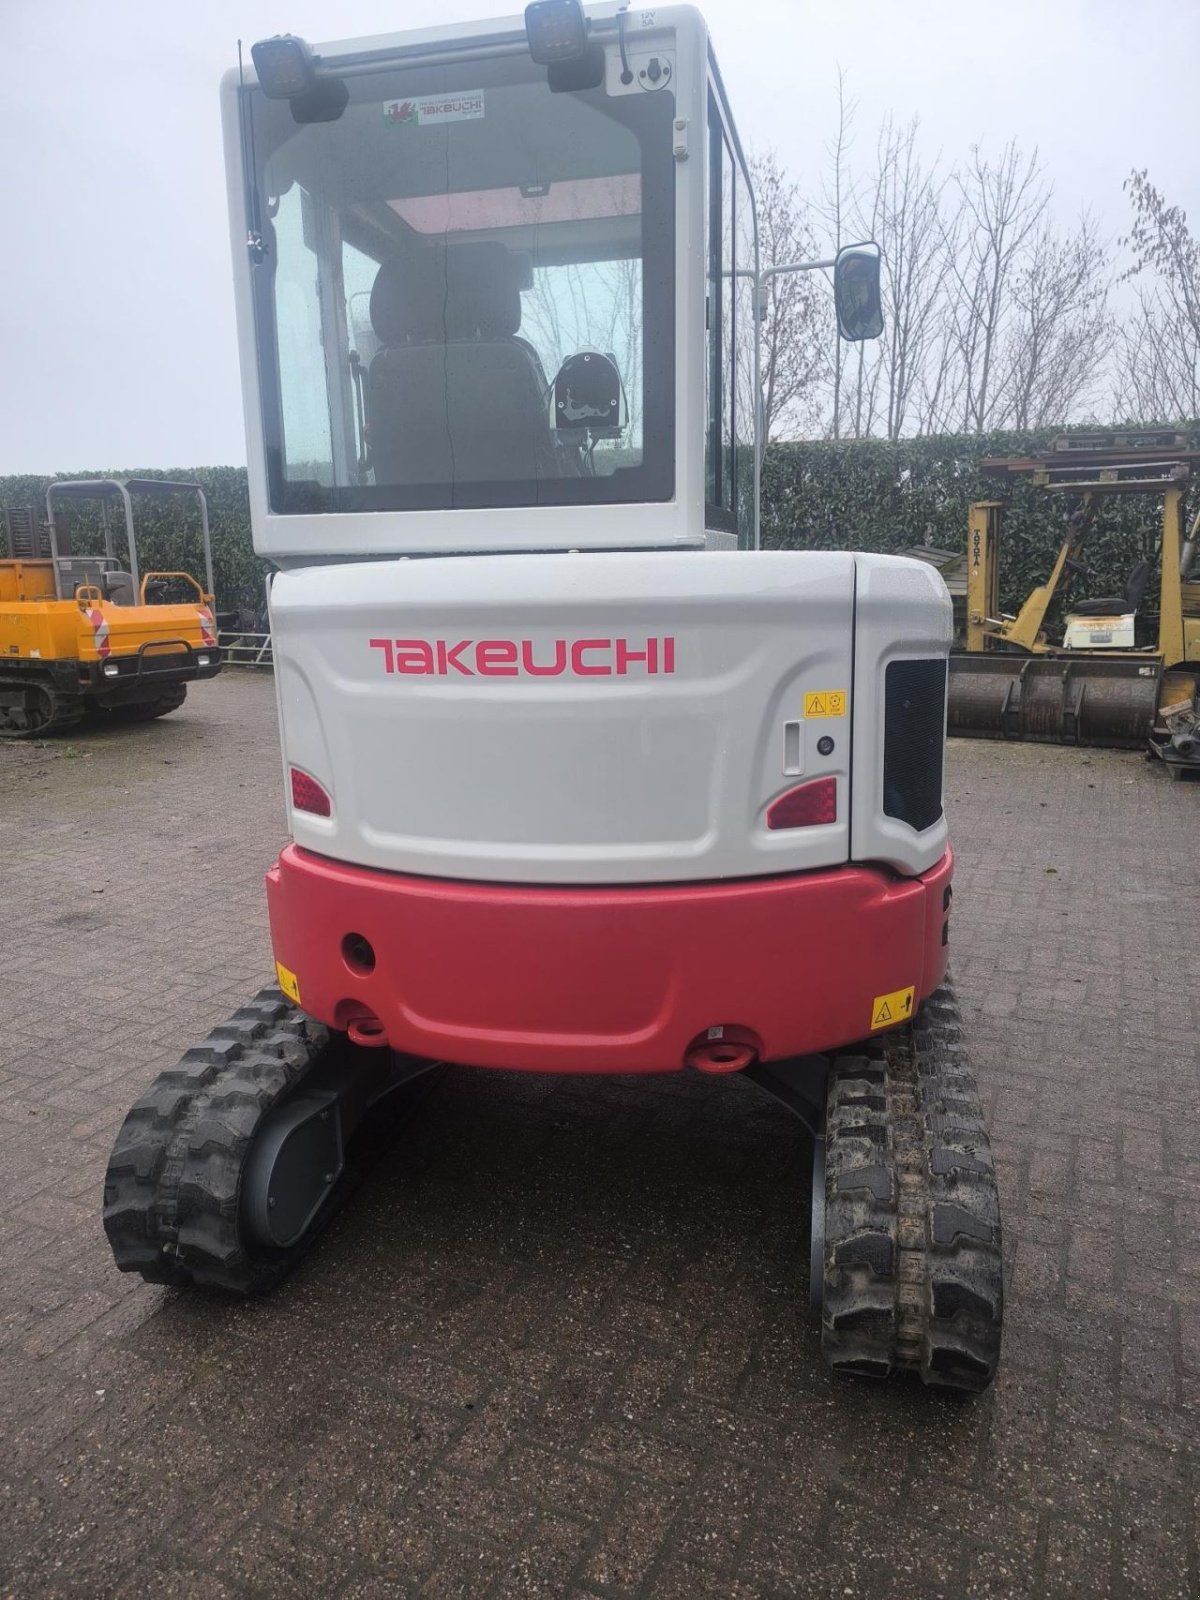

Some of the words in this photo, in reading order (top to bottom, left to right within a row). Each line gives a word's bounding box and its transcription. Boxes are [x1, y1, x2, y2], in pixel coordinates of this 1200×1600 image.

[641, 11, 656, 19] 12V
[973, 529, 981, 567] TOYOTA
[369, 636, 676, 676] TAKEUCHI
